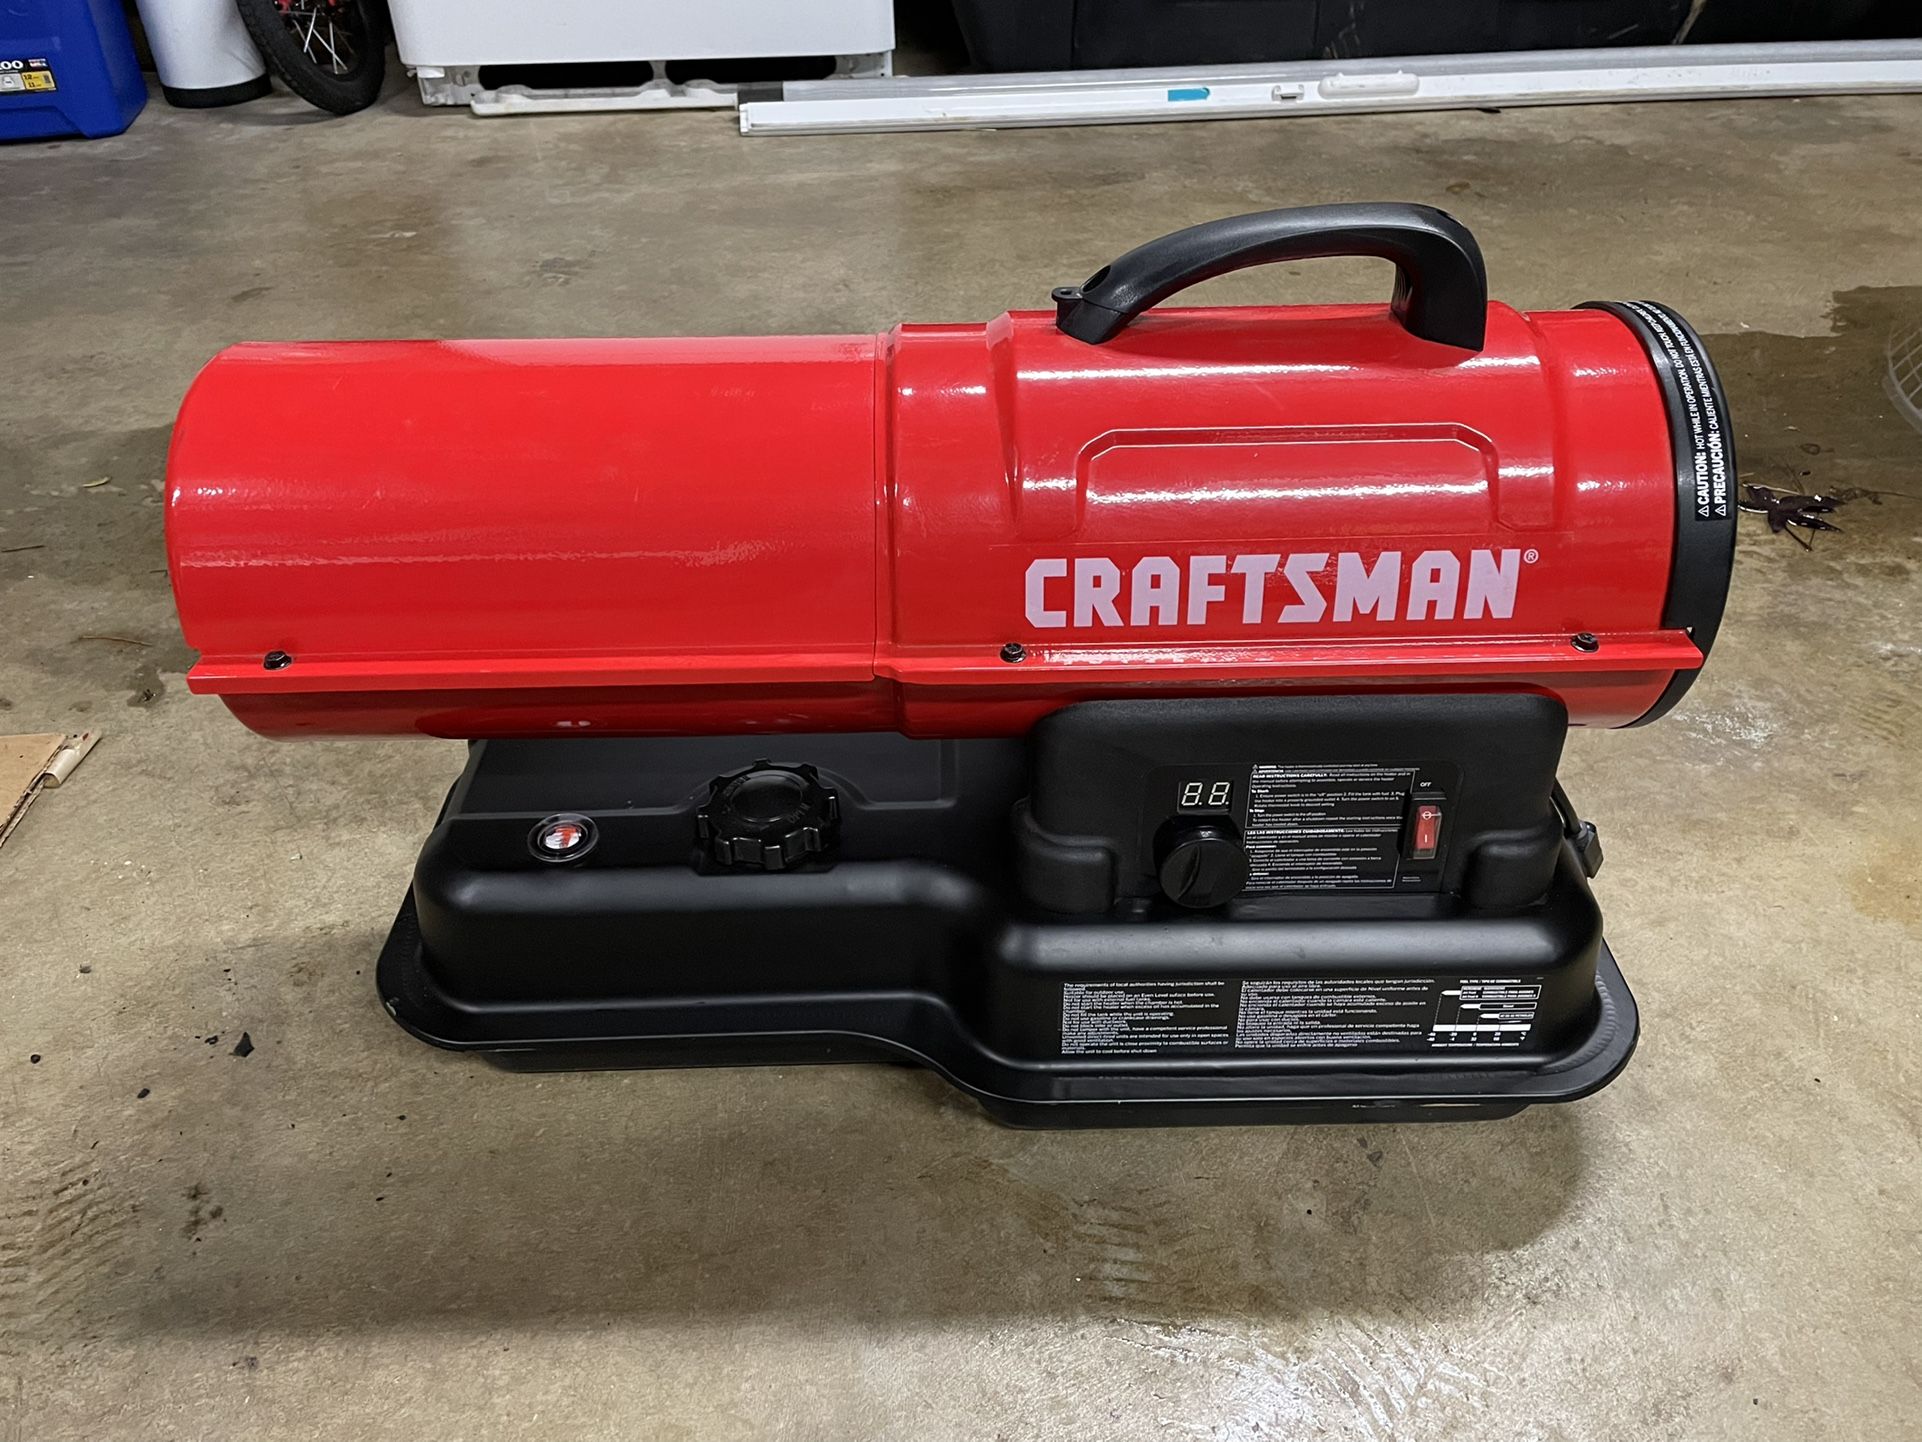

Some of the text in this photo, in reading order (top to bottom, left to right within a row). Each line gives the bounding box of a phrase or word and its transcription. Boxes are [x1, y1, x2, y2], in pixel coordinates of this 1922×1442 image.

[0, 60, 24, 70] 00
[1668, 349, 1680, 360] NOT
[1674, 360, 1684, 368] DO
[1692, 367, 1710, 397] MIENTRAS
[1690, 412, 1703, 434] WHILE
[1703, 398, 1719, 430] CALIENTE
[1694, 434, 1705, 449] HOT
[1694, 452, 1710, 505] CAUTION:
[1706, 430, 1726, 504] PRECAUCIÓN:
[1025, 548, 1521, 628] CRAFTSMAN
